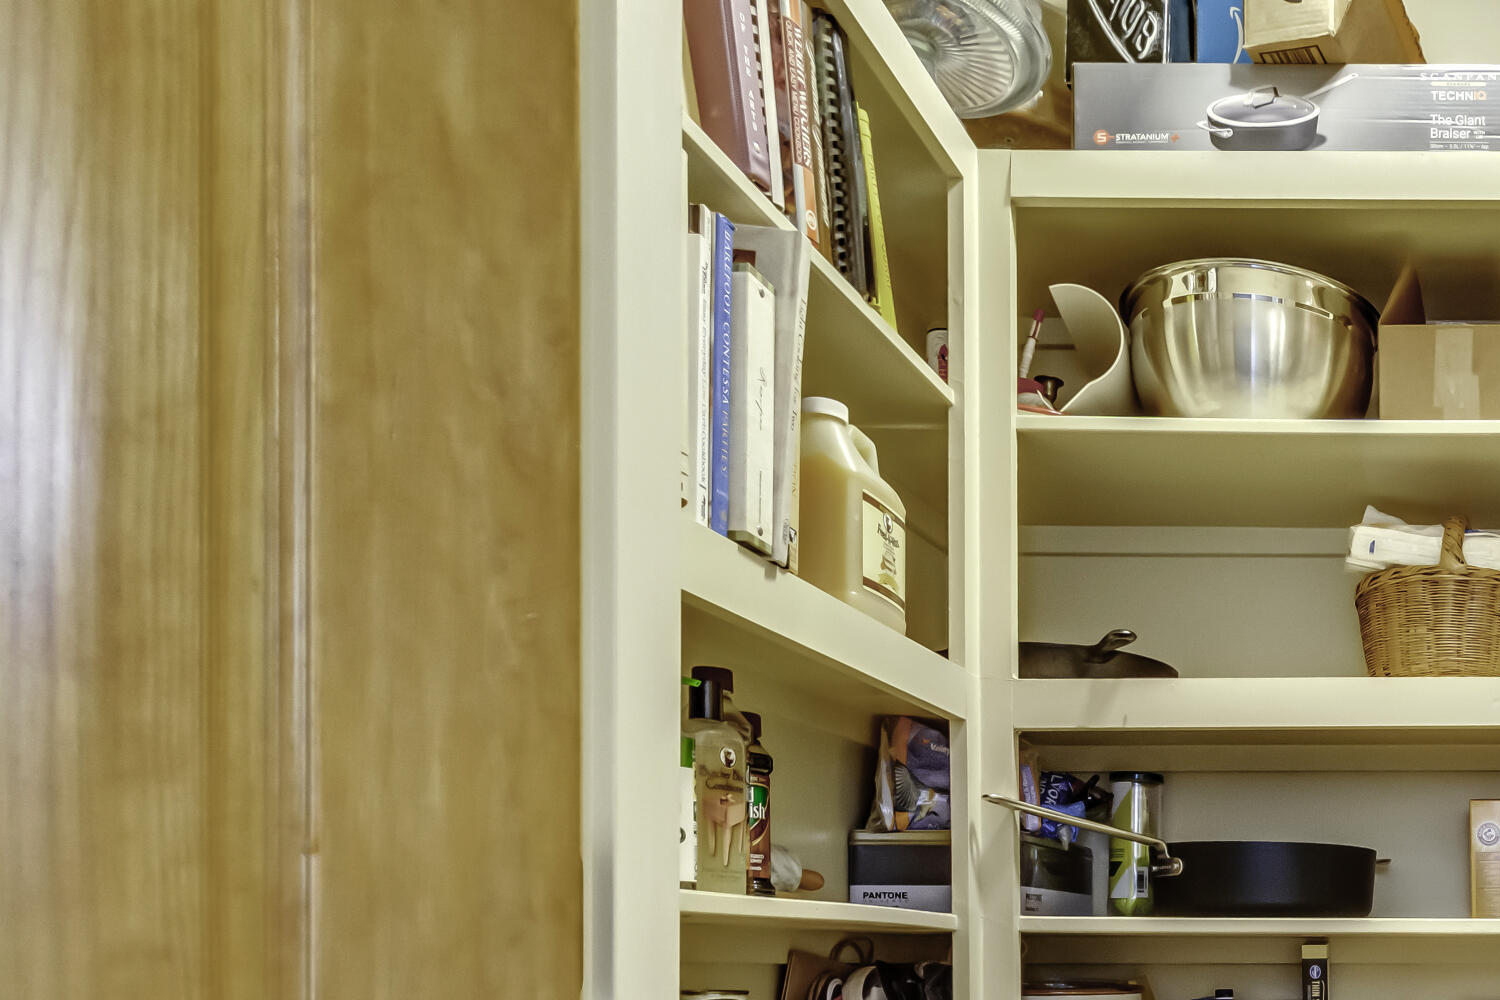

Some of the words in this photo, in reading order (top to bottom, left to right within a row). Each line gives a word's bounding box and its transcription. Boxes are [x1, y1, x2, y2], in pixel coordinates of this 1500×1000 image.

[1430, 114, 1453, 126] The
[1455, 114, 1486, 126] Giant
[1115, 133, 1169, 141] STRATANIUM
[1430, 127, 1471, 139] Braiser
[723, 229, 733, 316] BAREFOOT
[722, 322, 731, 404] CONTESSA
[863, 892, 908, 900] PANTONE
[1311, 980, 1321, 997] THIN
